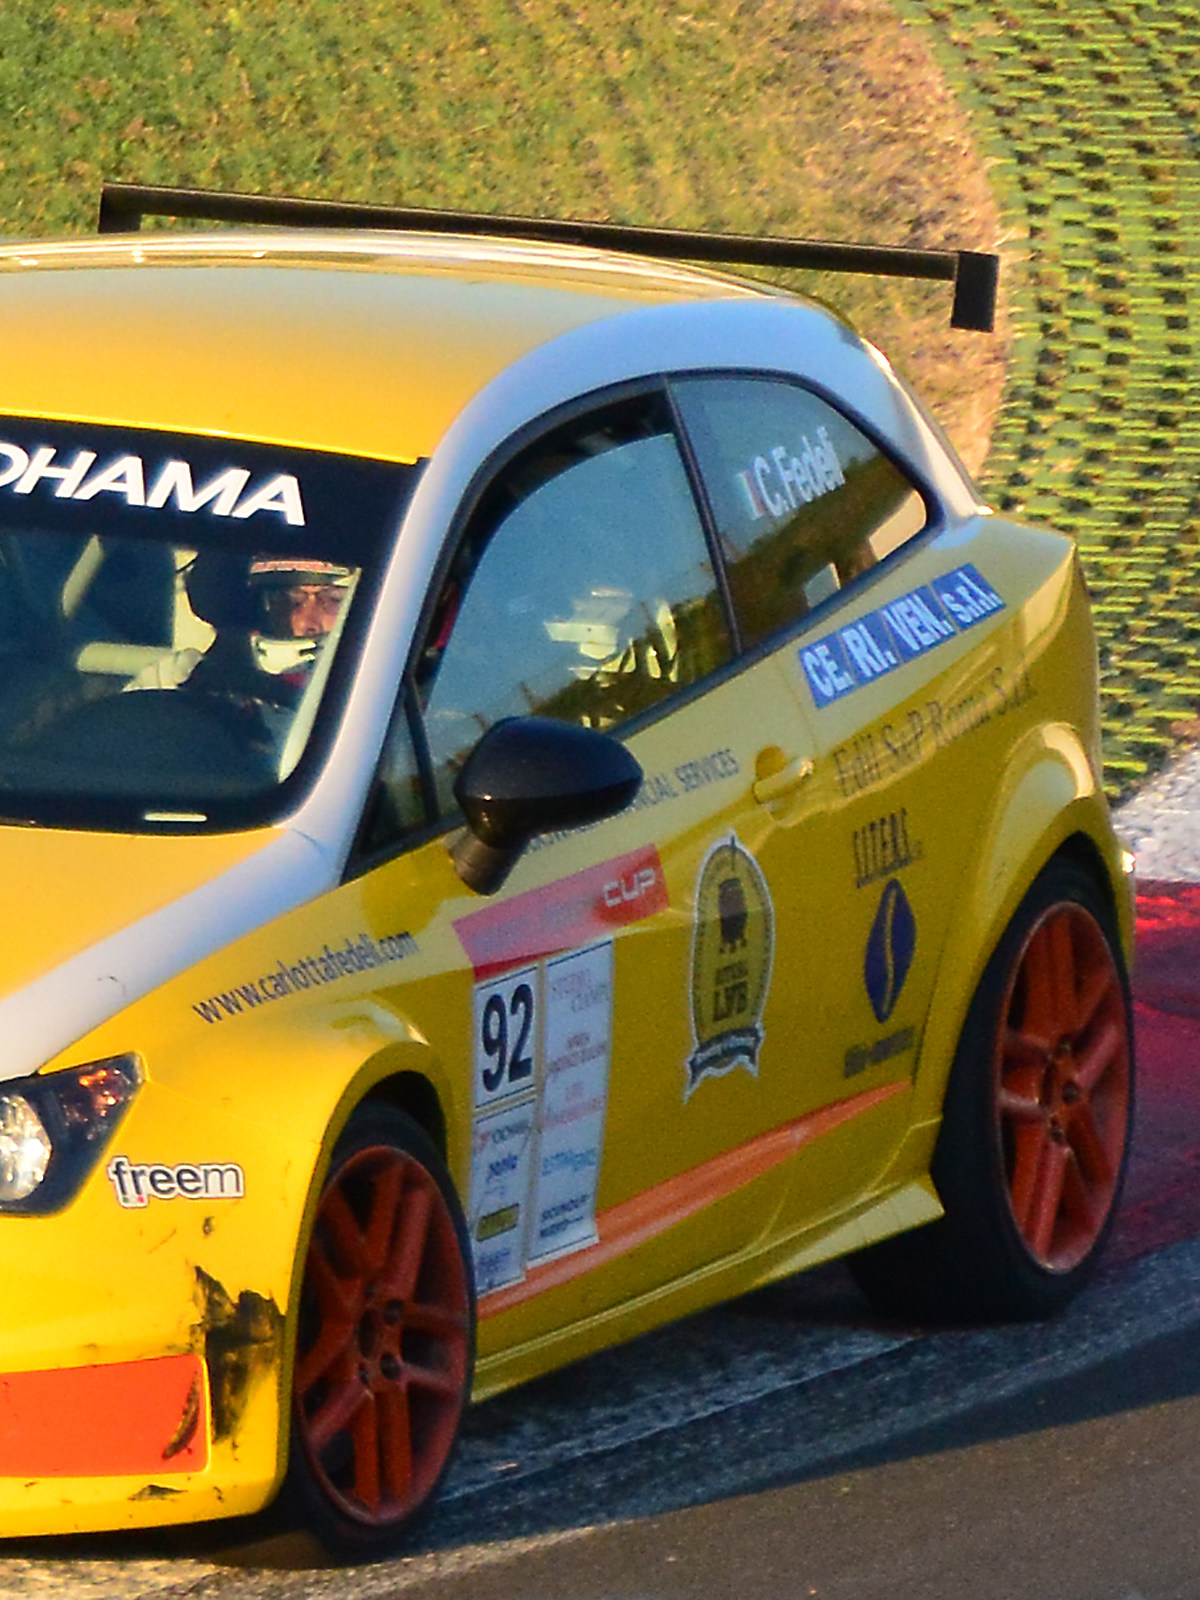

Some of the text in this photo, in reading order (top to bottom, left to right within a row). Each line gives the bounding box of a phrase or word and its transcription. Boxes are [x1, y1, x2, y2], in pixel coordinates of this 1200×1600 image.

[675, 749, 740, 793] SERVICES
[603, 868, 656, 907] CUP
[192, 931, 421, 1024] www.carlottafedeli.com
[481, 983, 534, 1092] 92
[113, 1160, 241, 1197] freem
